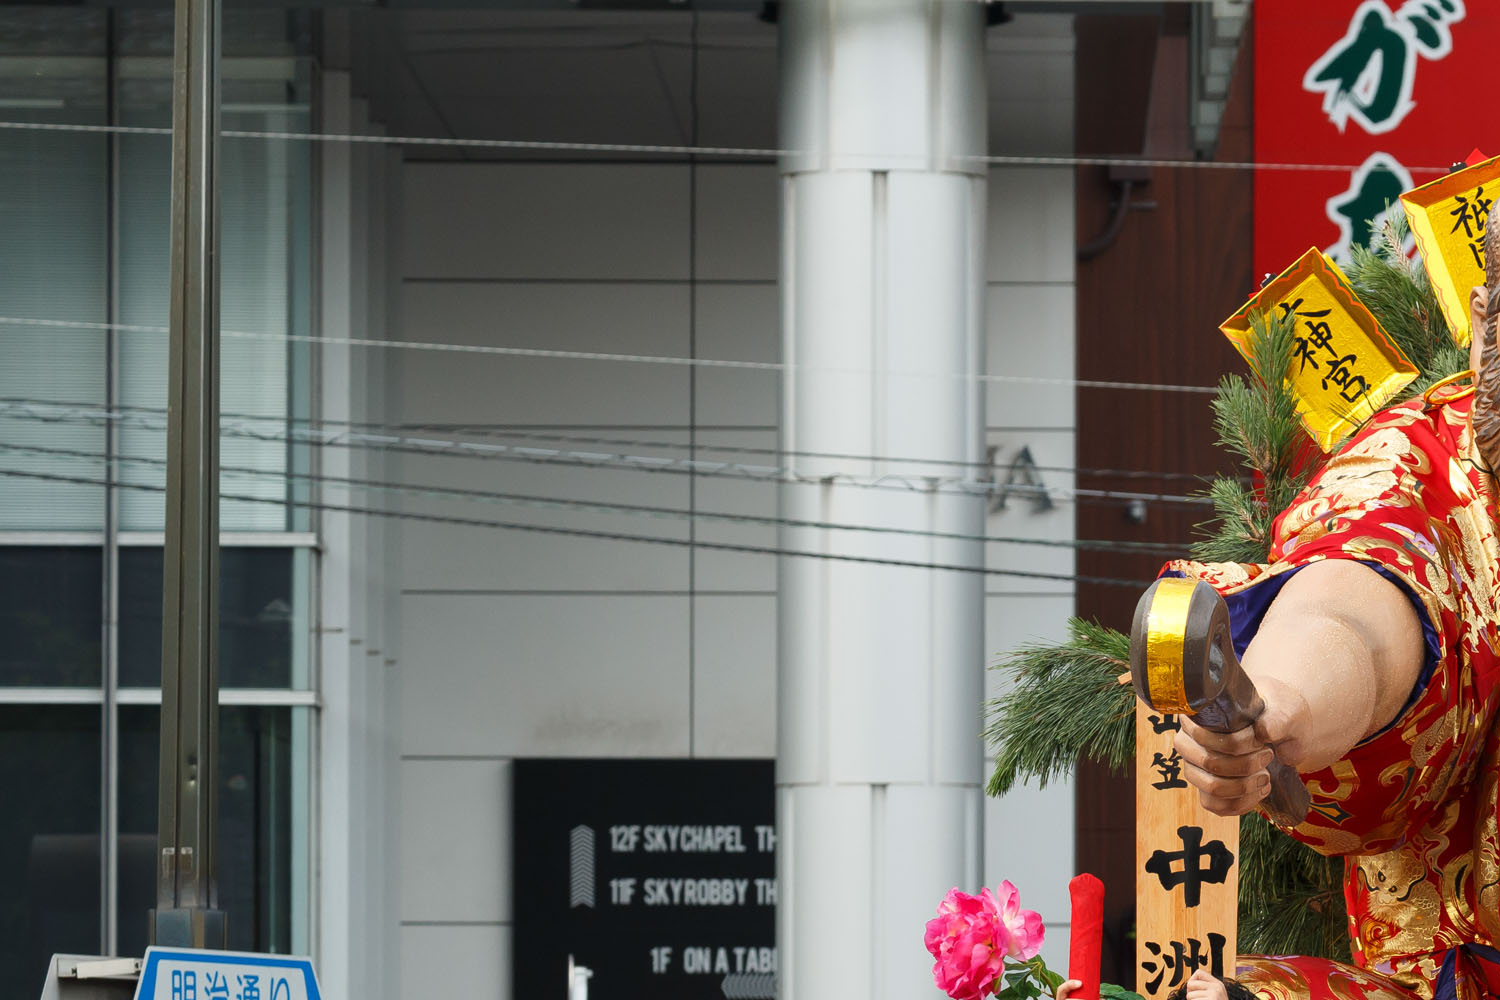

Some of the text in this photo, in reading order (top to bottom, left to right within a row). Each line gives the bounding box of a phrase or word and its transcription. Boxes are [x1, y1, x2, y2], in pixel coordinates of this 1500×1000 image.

[610, 825, 641, 852] 12F
[643, 825, 746, 852] SKYCHAPEL
[610, 878, 637, 904] 11F
[643, 878, 748, 905] SKYROBBY
[651, 946, 672, 973] 1F
[683, 946, 711, 973] ON
[715, 946, 730, 973] A
